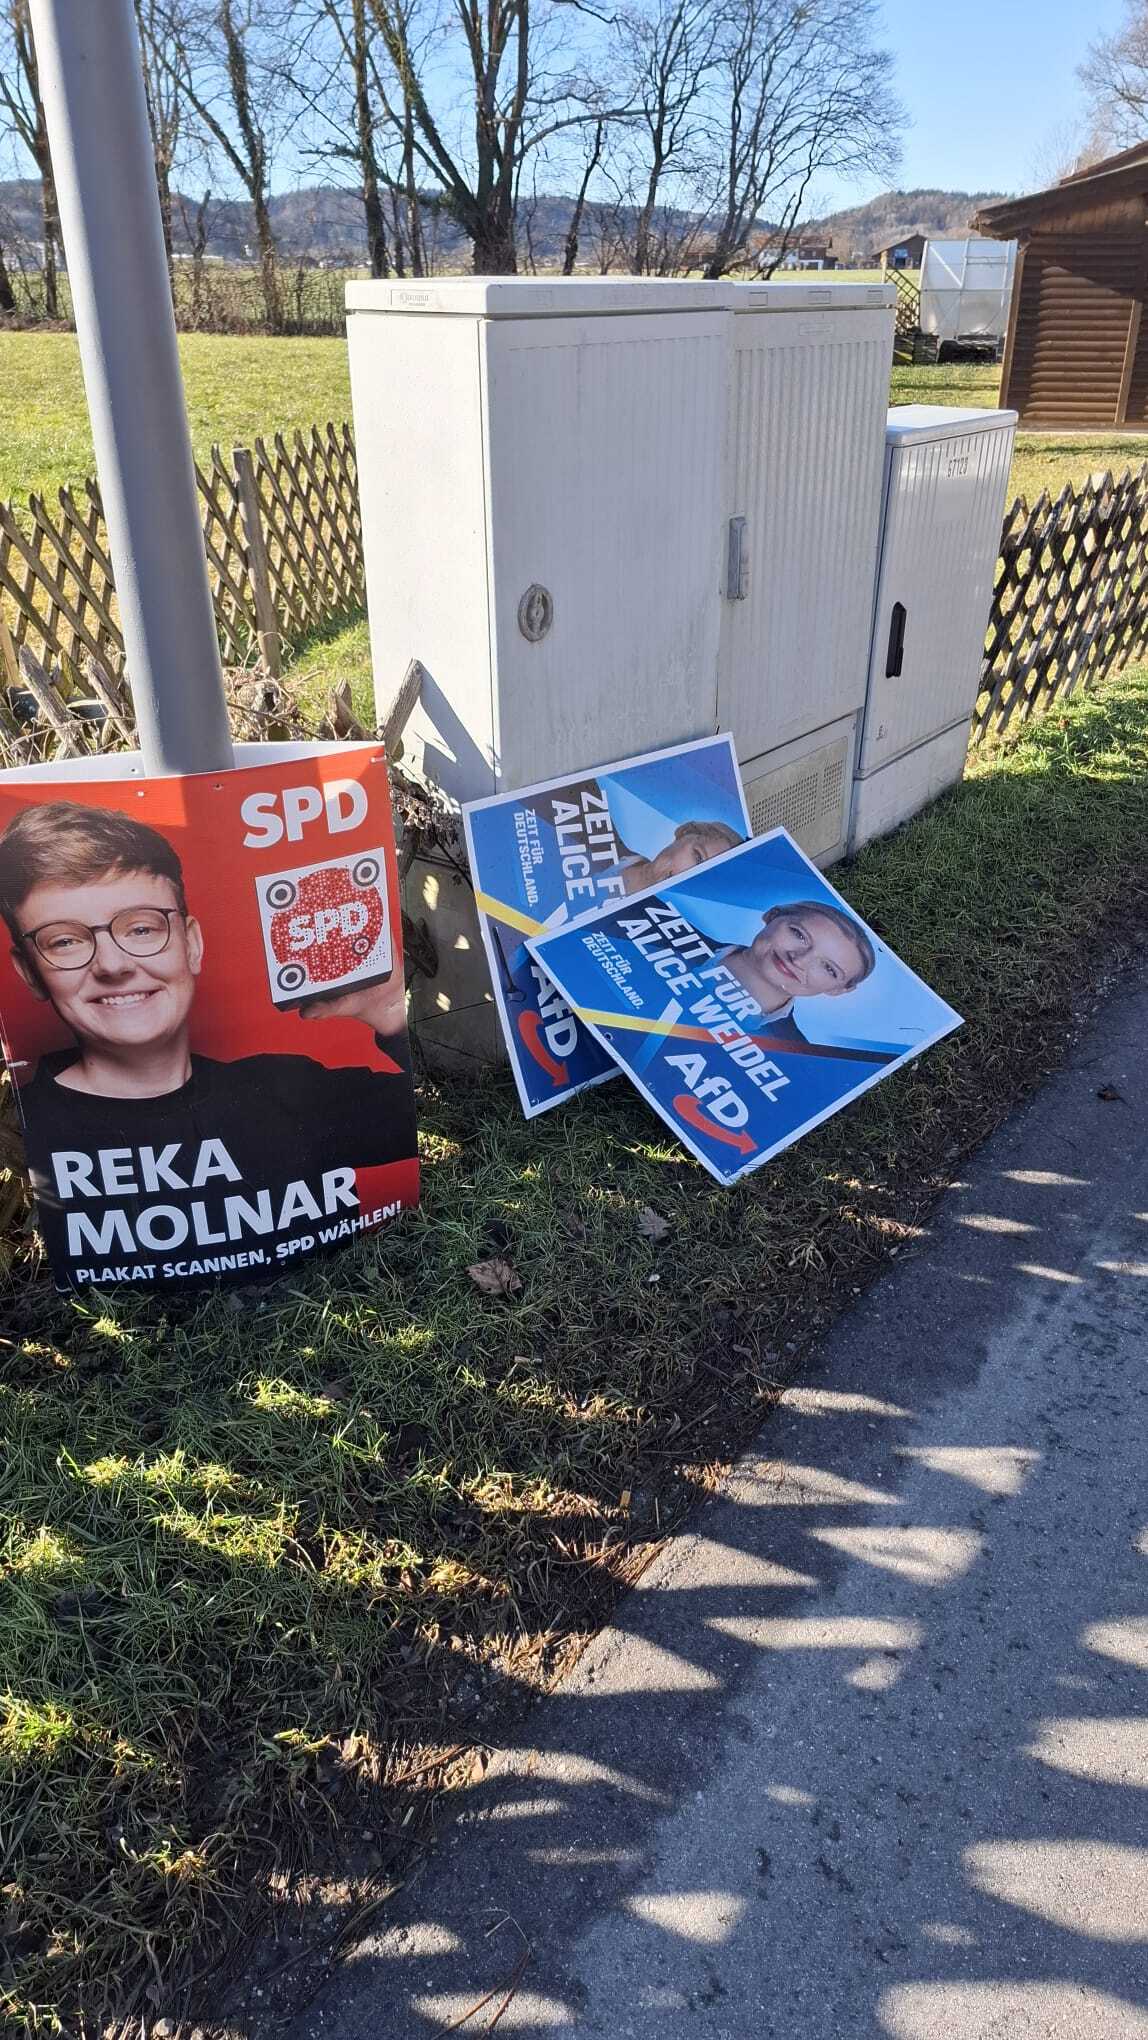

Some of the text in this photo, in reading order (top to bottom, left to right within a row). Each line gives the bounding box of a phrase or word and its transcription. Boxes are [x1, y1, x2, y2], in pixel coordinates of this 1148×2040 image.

[240, 778, 368, 848] SPD
[525, 808, 545, 865] ZEIT FÜR
[551, 800, 596, 901] ALICE
[580, 789, 620, 865] ZEIT
[513, 812, 539, 908] DEUTSCHLAND.
[288, 901, 368, 952] SPD
[591, 931, 633, 976] ZEIT FÜR
[644, 901, 762, 1022] ZEIT FÜR
[530, 965, 578, 1057] AfD
[581, 936, 645, 1010] DEUTSCHLAND.
[616, 919, 791, 1103] ALICE WEIDEL
[664, 1053, 749, 1128] AfD
[51, 1138, 243, 1199] REKA
[66, 1167, 361, 1257] MOLNAR
[76, 1200, 402, 1283] PLAKAT SCANNEN, SPD WÄHLEN!
